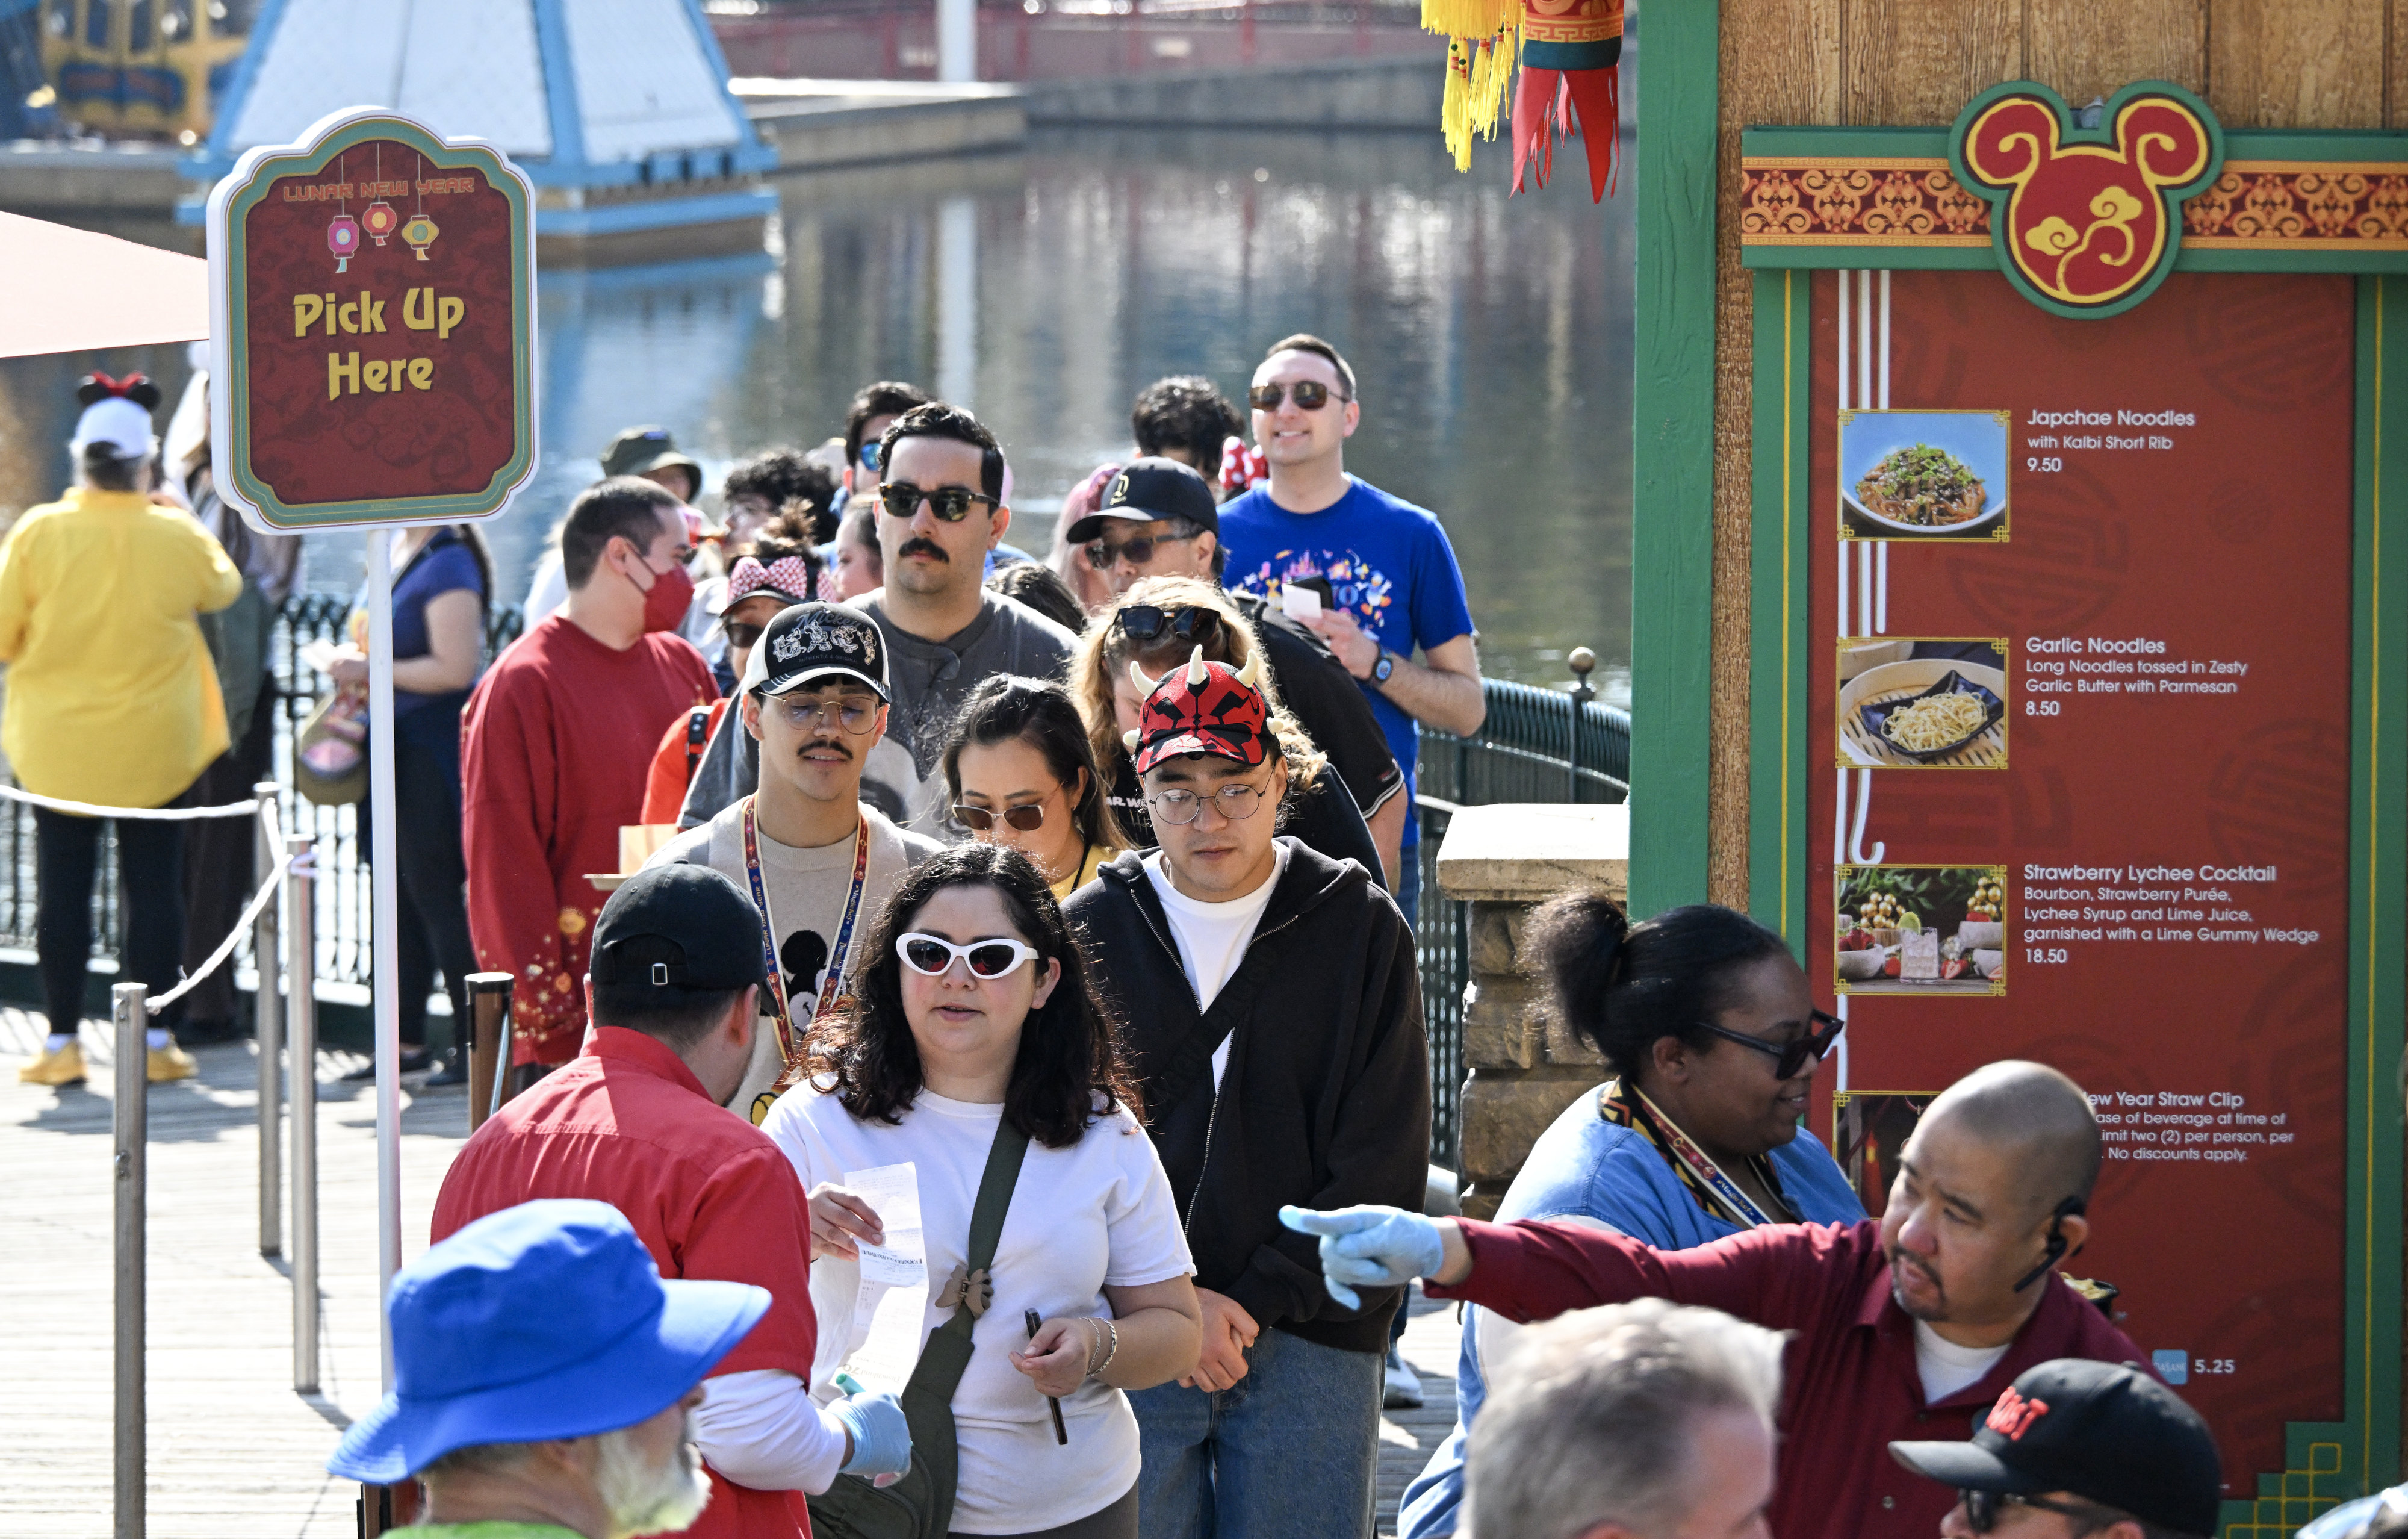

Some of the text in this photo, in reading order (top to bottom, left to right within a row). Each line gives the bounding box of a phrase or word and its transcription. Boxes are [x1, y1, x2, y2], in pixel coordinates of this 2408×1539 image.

[284, 178, 474, 201] LUNAR NEW YEAR
[293, 287, 465, 339] Pick Up
[328, 352, 433, 401] Here
[2027, 410, 2195, 428] Japchae Noodles
[2028, 435, 2173, 449] with Kalbi Short Rib
[2027, 458, 2061, 472] 9.50
[2026, 637, 2165, 653] Garlic Noodles
[798, 654, 828, 663] AUTHENTIC
[2027, 659, 2247, 675] Long Noodles tossed in Zesty
[2026, 679, 2236, 692] Garlic Butter with Parmesan
[2026, 701, 2059, 715] 8.50
[2024, 864, 2275, 883] Strawberry Lychee Cocktail
[756, 886, 764, 907] YEAR
[2025, 887, 2231, 903] Bourbon, Strawberry Purée,
[2025, 907, 2251, 922] Lychee Syrup and Lime Juice,
[763, 930, 772, 955] LUNAR
[2024, 927, 2318, 944] garnished with a Lime Gummy Wedge
[2026, 949, 2067, 963] 18.50
[2116, 1092, 2154, 1105] Year
[2159, 1092, 2204, 1106] Straw
[2209, 1092, 2243, 1109] Clip
[2126, 1112, 2140, 1123] of
[2144, 1112, 2213, 1127] beverage
[2217, 1113, 2232, 1124] at
[2236, 1113, 2267, 1124] time
[2271, 1113, 2285, 1124] of
[2100, 1130, 2293, 1145] imit two (2) per person, per
[2109, 1148, 2129, 1159] No
[2133, 1148, 2200, 1159] discounts
[2204, 1148, 2247, 1161] apply.
[2195, 1360, 2234, 1373] 5.25
